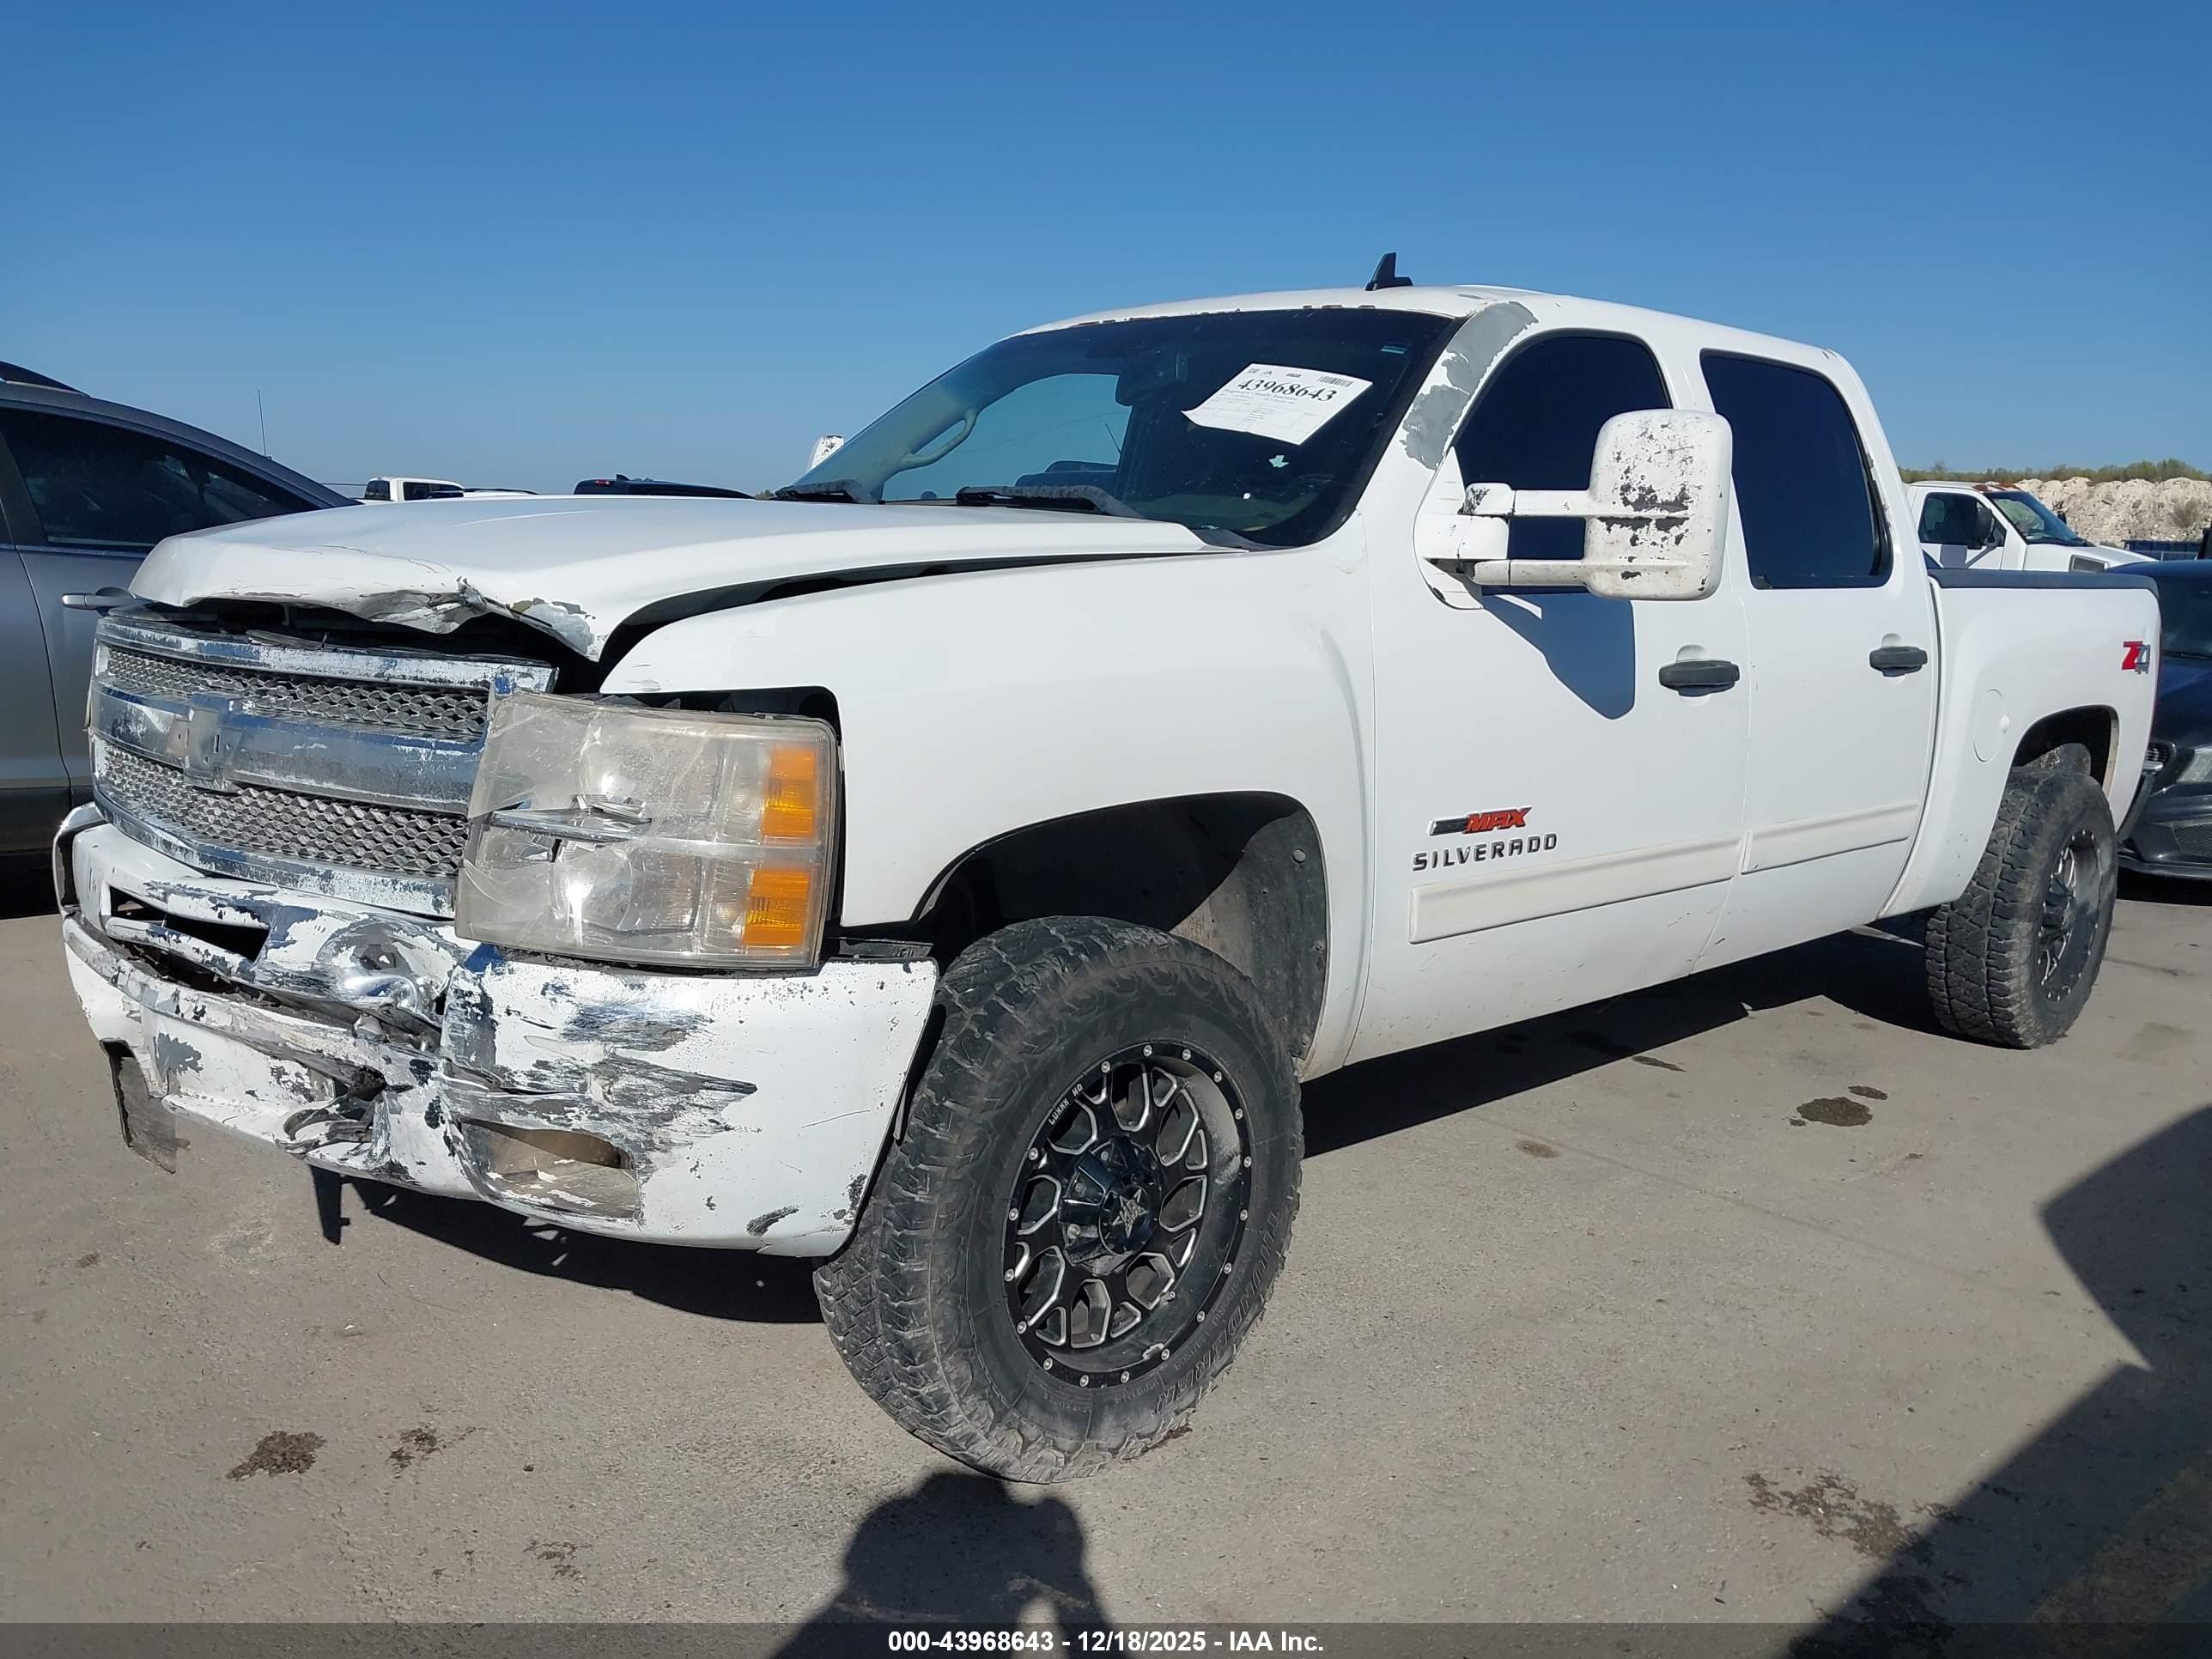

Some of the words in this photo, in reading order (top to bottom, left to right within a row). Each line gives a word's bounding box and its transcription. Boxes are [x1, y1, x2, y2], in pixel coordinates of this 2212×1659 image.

[1237, 379, 1337, 402] 43968643
[1463, 807, 1532, 834] MAX
[1413, 833, 1558, 872] SILVERADO
